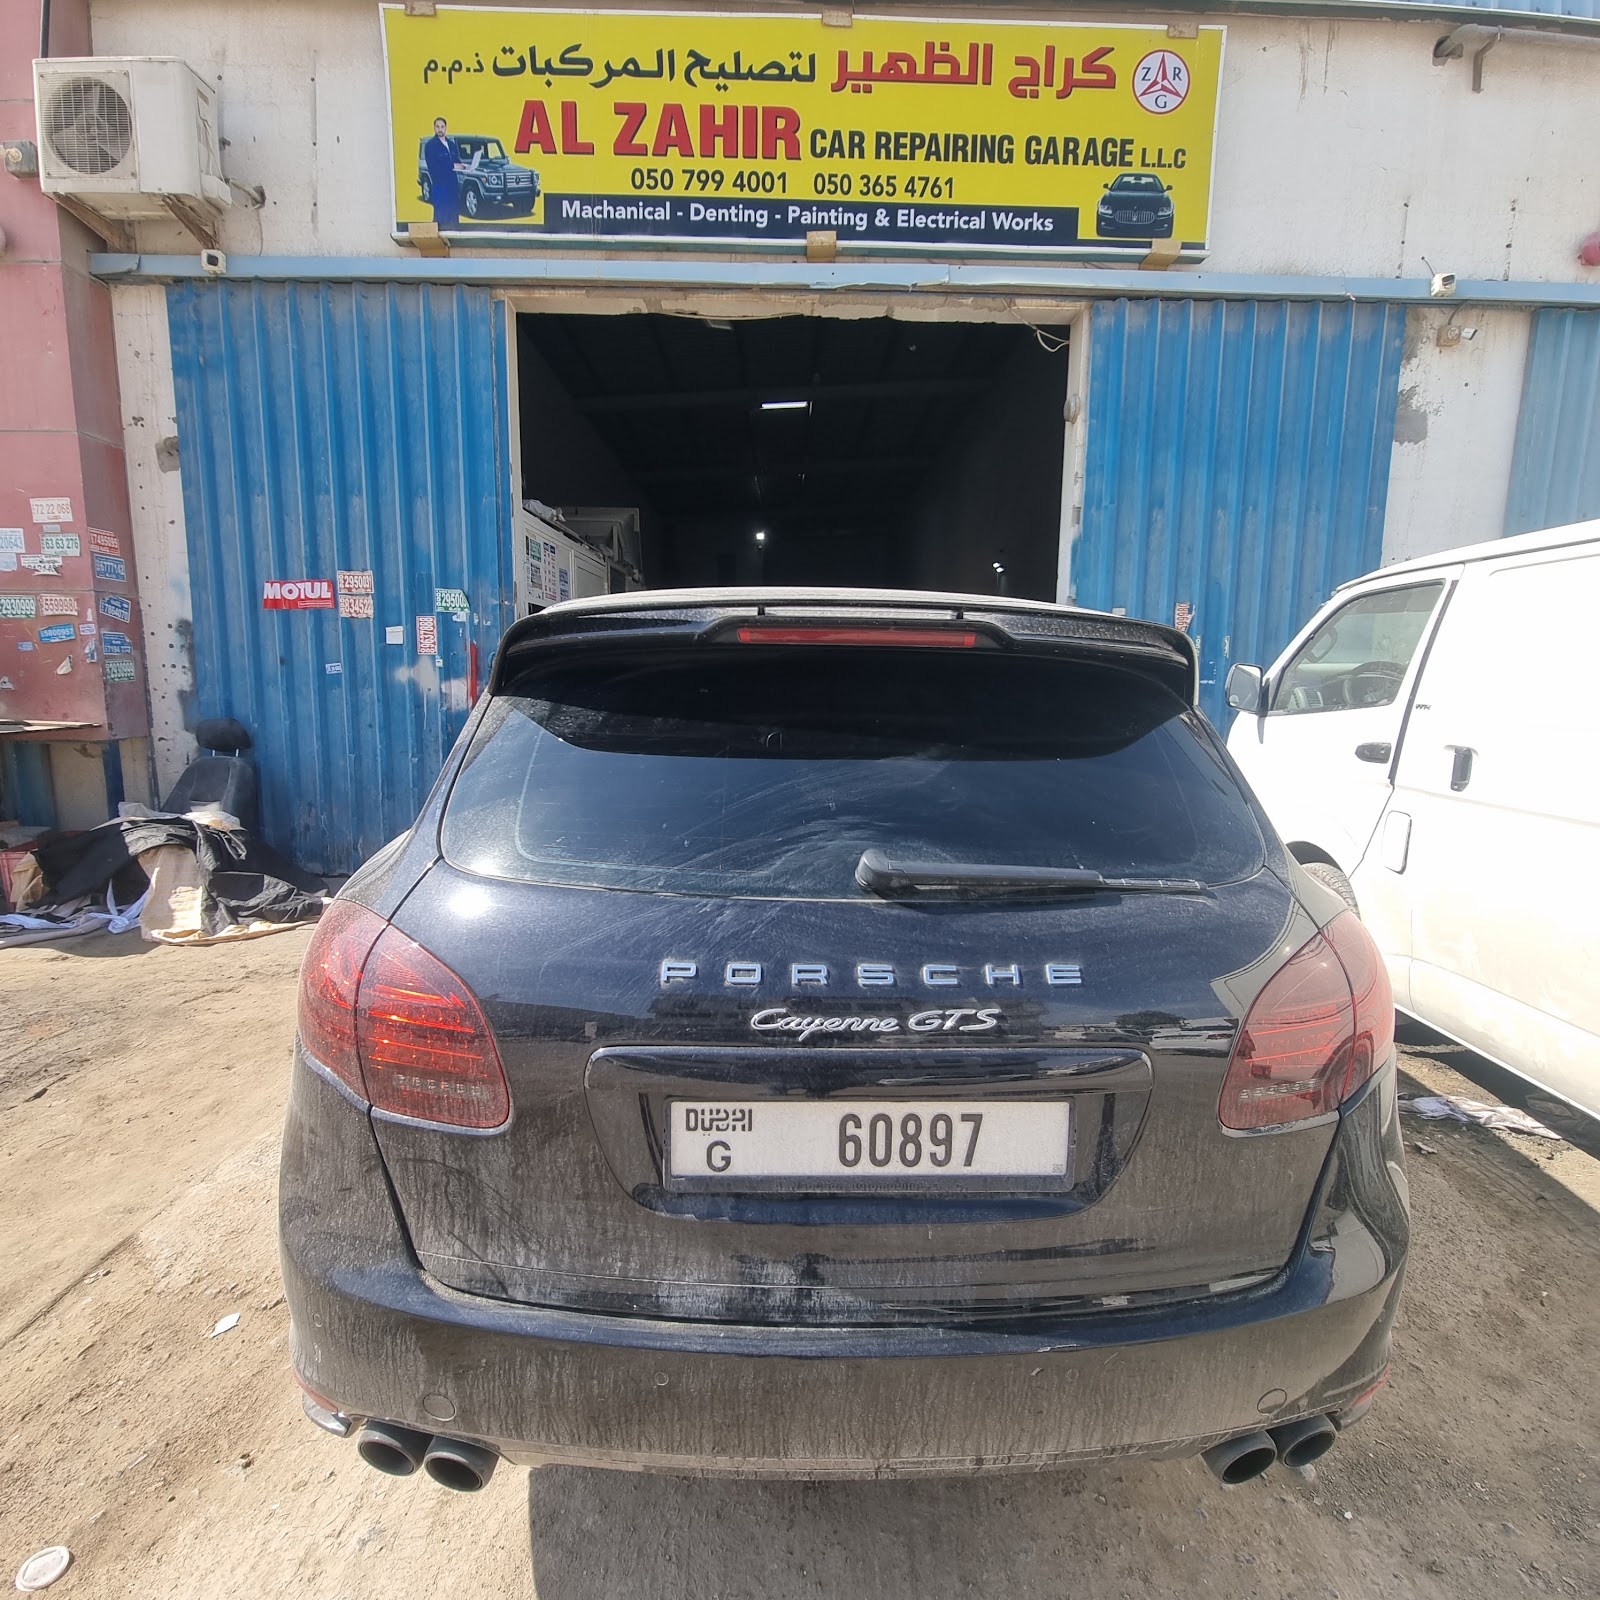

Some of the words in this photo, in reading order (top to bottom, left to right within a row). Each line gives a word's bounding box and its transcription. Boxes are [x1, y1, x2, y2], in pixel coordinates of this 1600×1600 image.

[492, 43, 674, 89] المركبات
[684, 48, 817, 92] لتصليح
[830, 41, 993, 94] الظهير
[1007, 46, 1117, 99] كراج
[514, 100, 595, 155] AL
[613, 102, 802, 161] ZAHIR
[810, 128, 865, 160] CAR
[875, 132, 1014, 165] REPAIRING
[1024, 135, 1134, 168] GARAGE
[1141, 147, 1187, 169] L.L.C
[631, 168, 673, 191] 050
[683, 169, 725, 193] 799
[732, 171, 788, 194] 4001
[813, 173, 851, 196] 050
[859, 174, 897, 197] 365
[904, 176, 955, 200] 4761
[561, 199, 671, 223] Machanical
[690, 203, 768, 228] Denting
[787, 205, 867, 231] Painting
[874, 208, 891, 227] &
[897, 209, 985, 231] Electrical
[992, 211, 1054, 232] Works
[263, 582, 331, 600] MOTUL
[660, 961, 1083, 987] PORSCHE
[750, 1008, 900, 1041] Cayenne
[908, 1008, 1002, 1032] GTS
[706, 1140, 732, 1173] G
[838, 1113, 984, 1168] 60897
